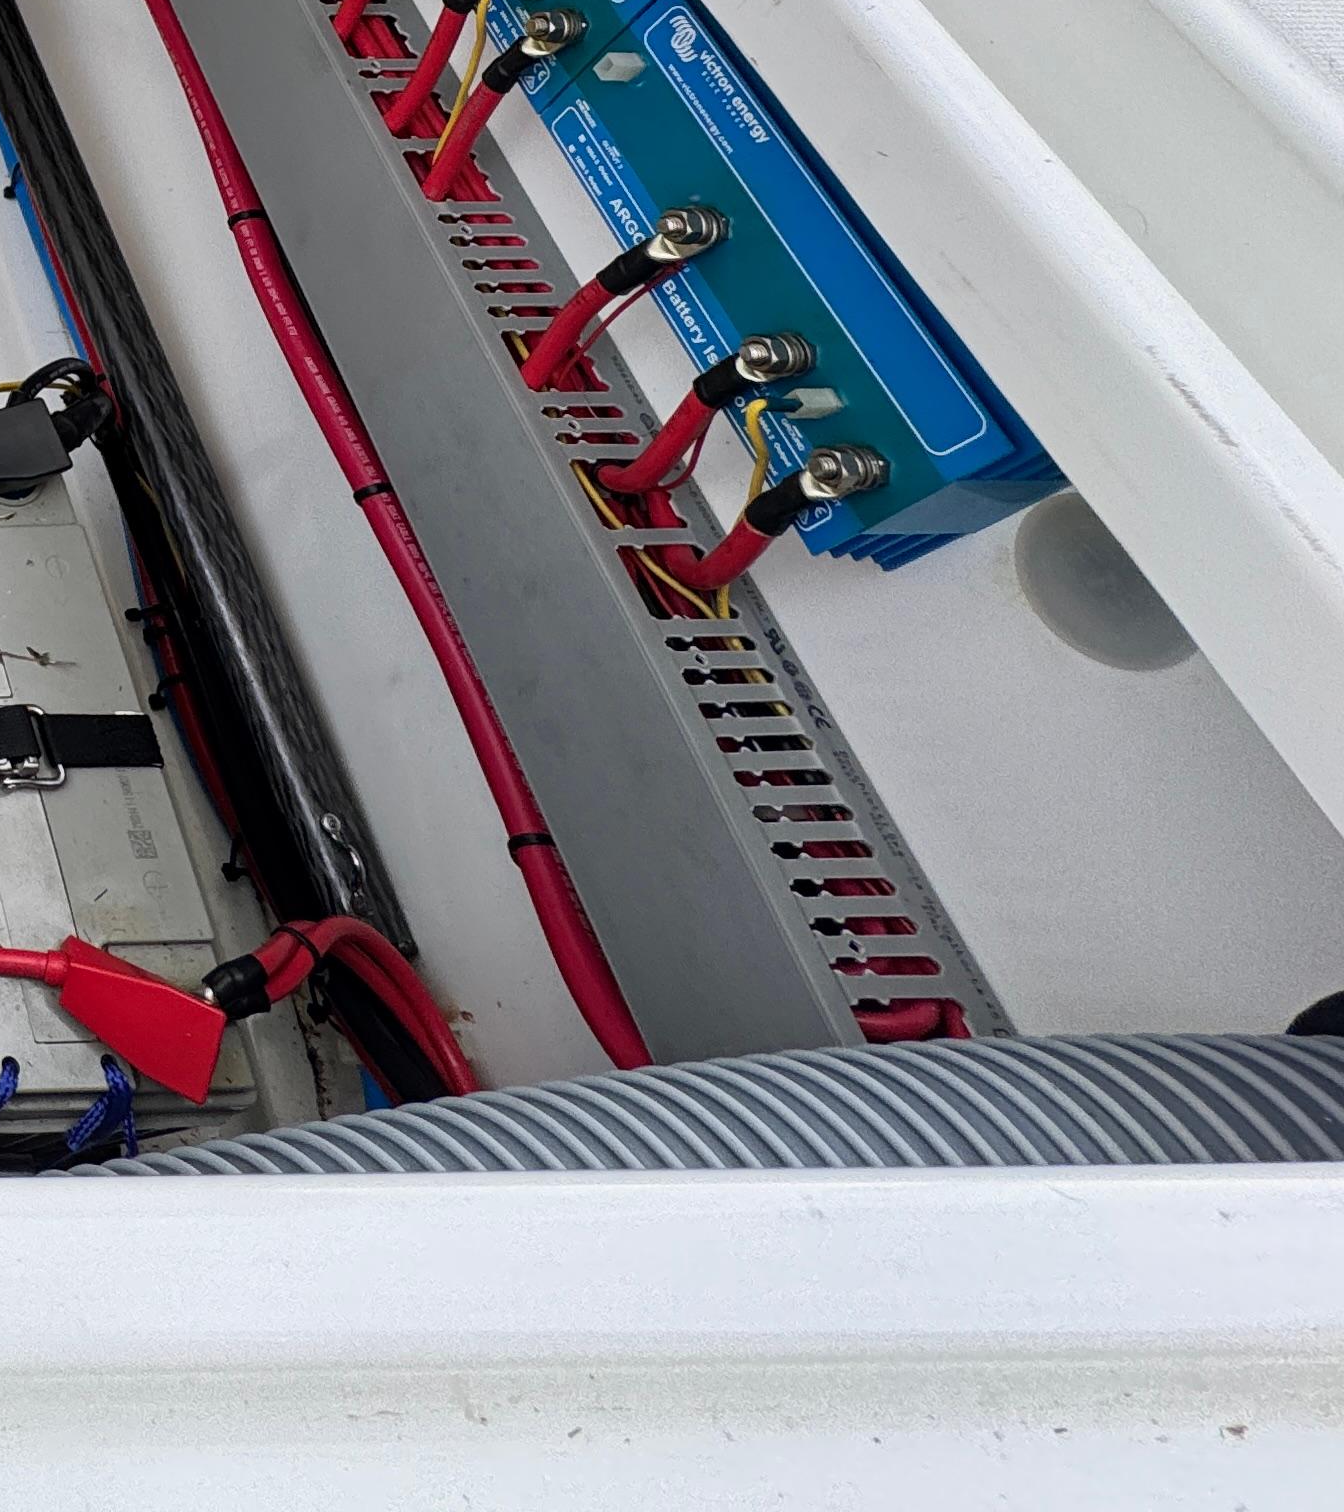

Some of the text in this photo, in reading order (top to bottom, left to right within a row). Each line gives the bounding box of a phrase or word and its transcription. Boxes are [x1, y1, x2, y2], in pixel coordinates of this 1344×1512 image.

[669, 63, 734, 154] www.victronenergy.com
[700, 50, 770, 143] victron energy
[662, 279, 707, 345] Battery
